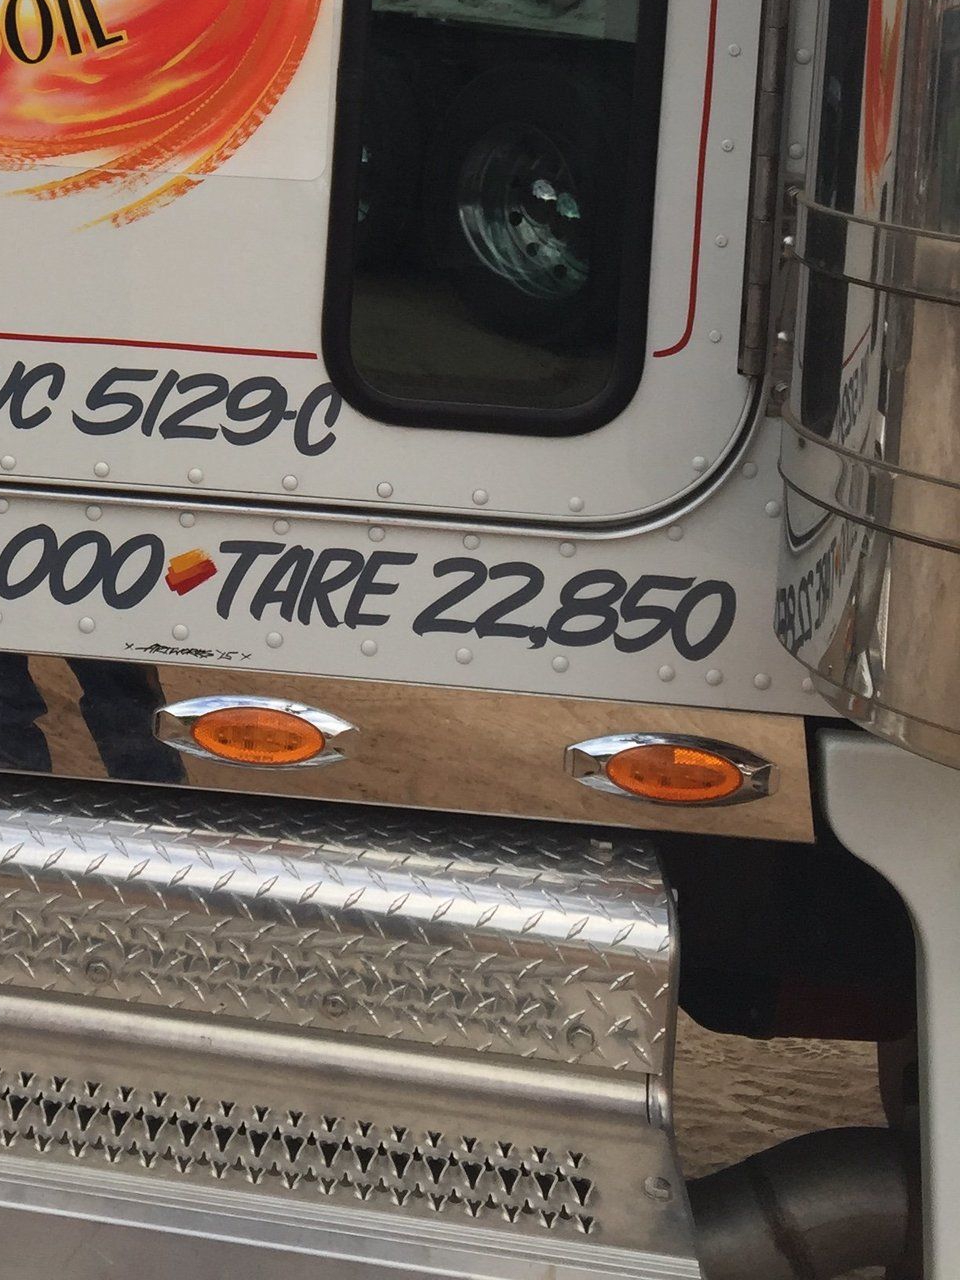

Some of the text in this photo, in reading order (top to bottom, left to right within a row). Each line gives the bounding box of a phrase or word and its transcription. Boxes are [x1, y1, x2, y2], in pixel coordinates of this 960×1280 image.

[71, 365, 342, 457] 5129-C
[214, 540, 418, 630] TARE
[411, 556, 737, 662] 22,850
